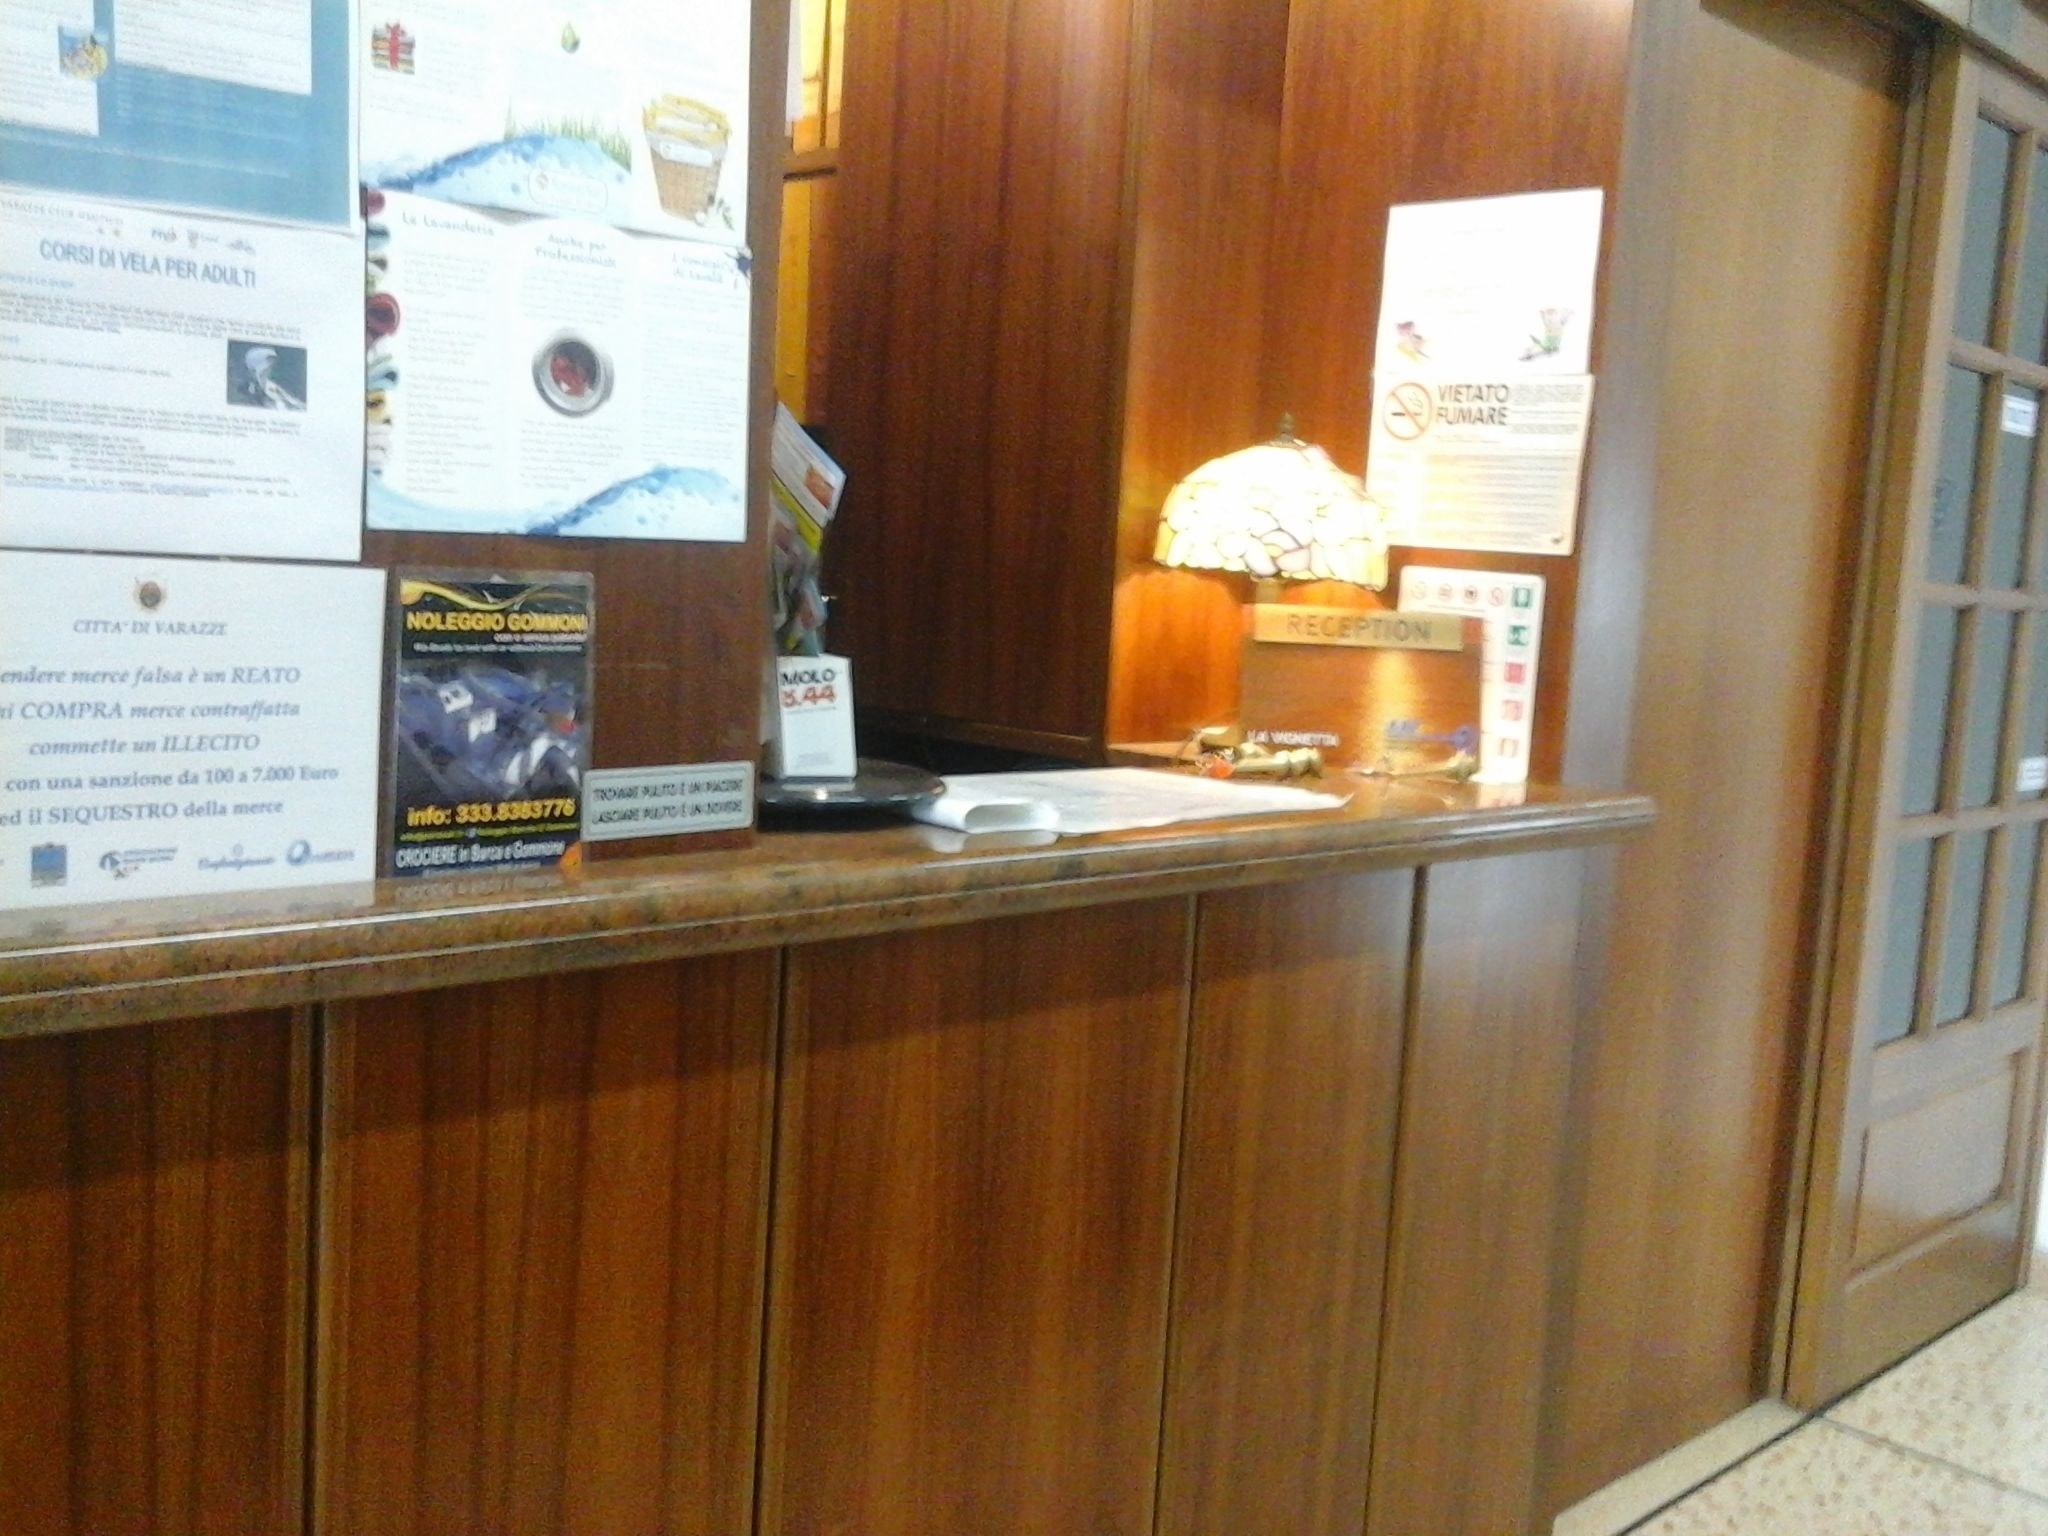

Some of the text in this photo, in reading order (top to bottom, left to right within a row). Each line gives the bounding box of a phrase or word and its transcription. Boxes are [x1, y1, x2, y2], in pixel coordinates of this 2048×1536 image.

[423, 214, 495, 236] Lavanderia
[40, 238, 256, 289] CORSI DI VELA PER ADULTI
[1437, 384, 1510, 405] VIETATO
[1435, 406, 1509, 427] FUMARE
[131, 619, 150, 634] DI
[155, 619, 228, 636] VARAZZE
[406, 610, 589, 633] NOLEGGIO GOMMONI
[1286, 613, 1433, 642] RECEPTION
[72, 669, 131, 684] merce
[131, 665, 183, 688] falsa
[203, 669, 226, 684] un
[231, 666, 300, 684] REATO
[780, 668, 836, 687] MOLO
[20, 701, 123, 720] COMPRA
[130, 704, 187, 719] merce
[191, 701, 300, 722] contraffatta
[29, 733, 260, 756] commette un ILLECITO
[5, 765, 339, 793] con una sanzione da 100 a 7.000 Euro
[0, 799, 284, 828] ed il SEQUESTRO della merce
[395, 844, 458, 868] CROCIERE
